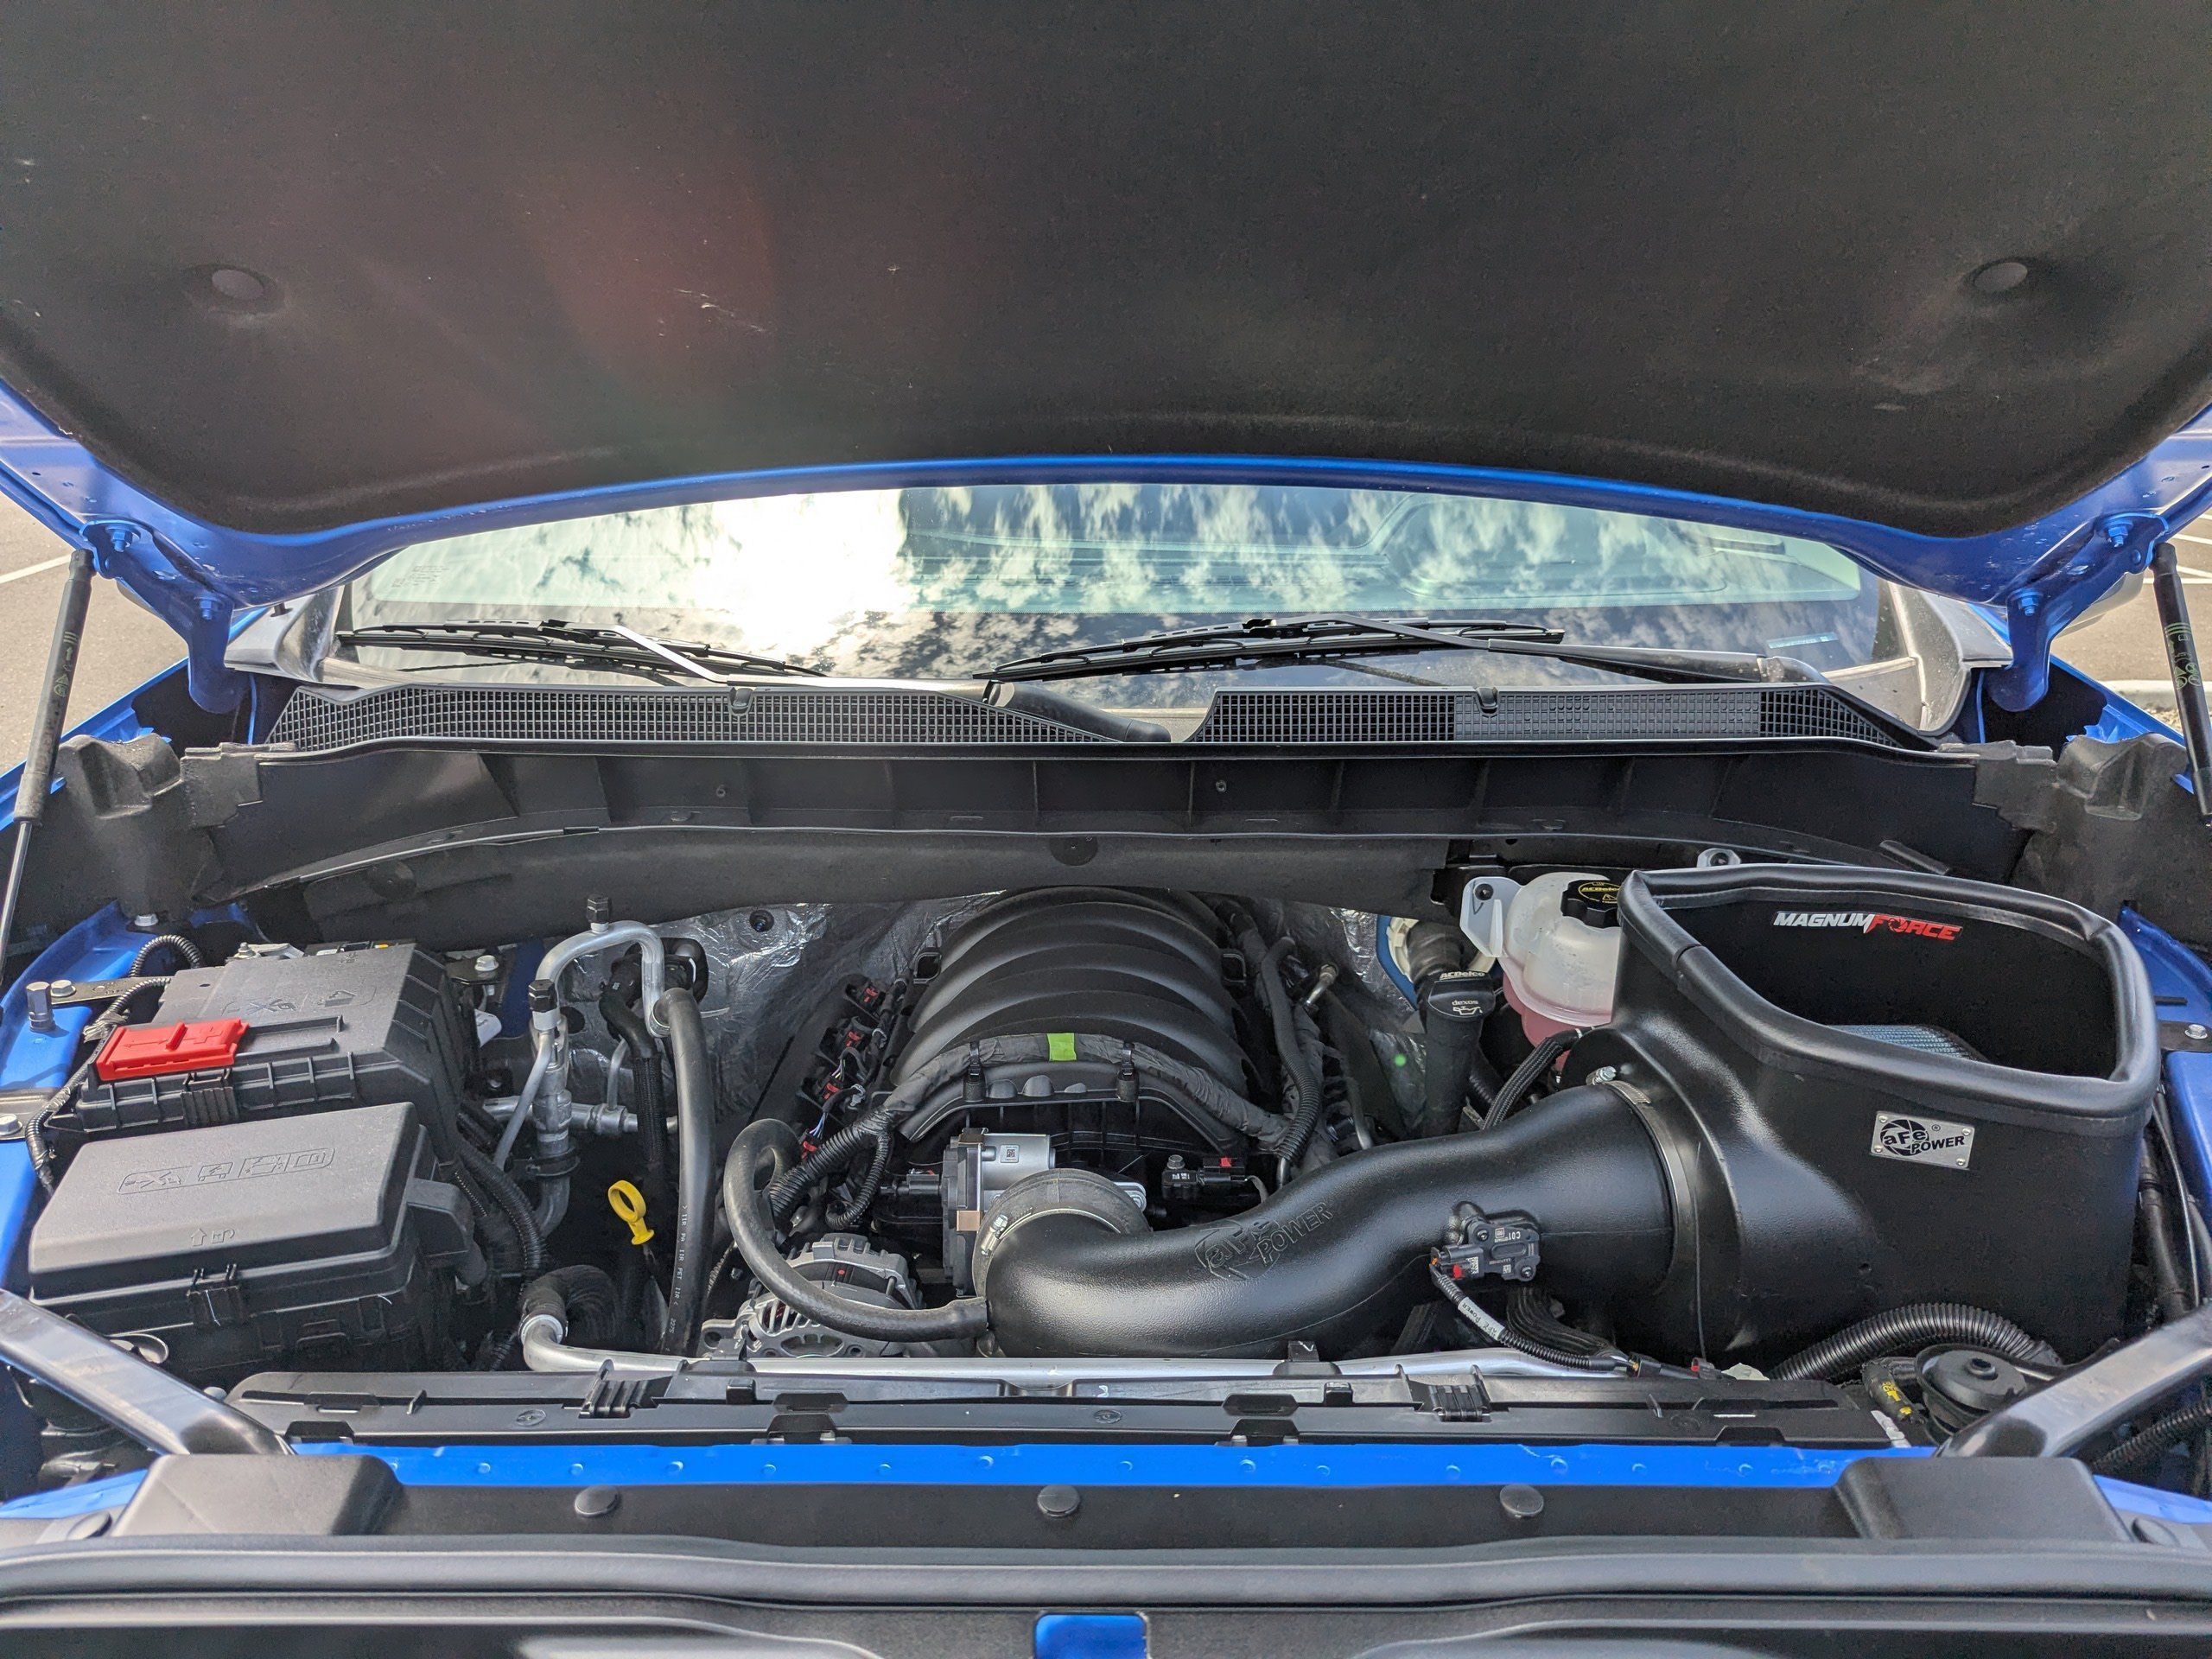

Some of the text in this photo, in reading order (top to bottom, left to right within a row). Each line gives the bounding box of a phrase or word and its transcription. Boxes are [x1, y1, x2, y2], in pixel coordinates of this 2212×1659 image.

[1440, 971, 1485, 981] ACDelco
[1883, 1130, 1926, 1146] aFe
[1911, 1135, 1965, 1154] POWER
[1256, 1202, 1334, 1266] POWER
